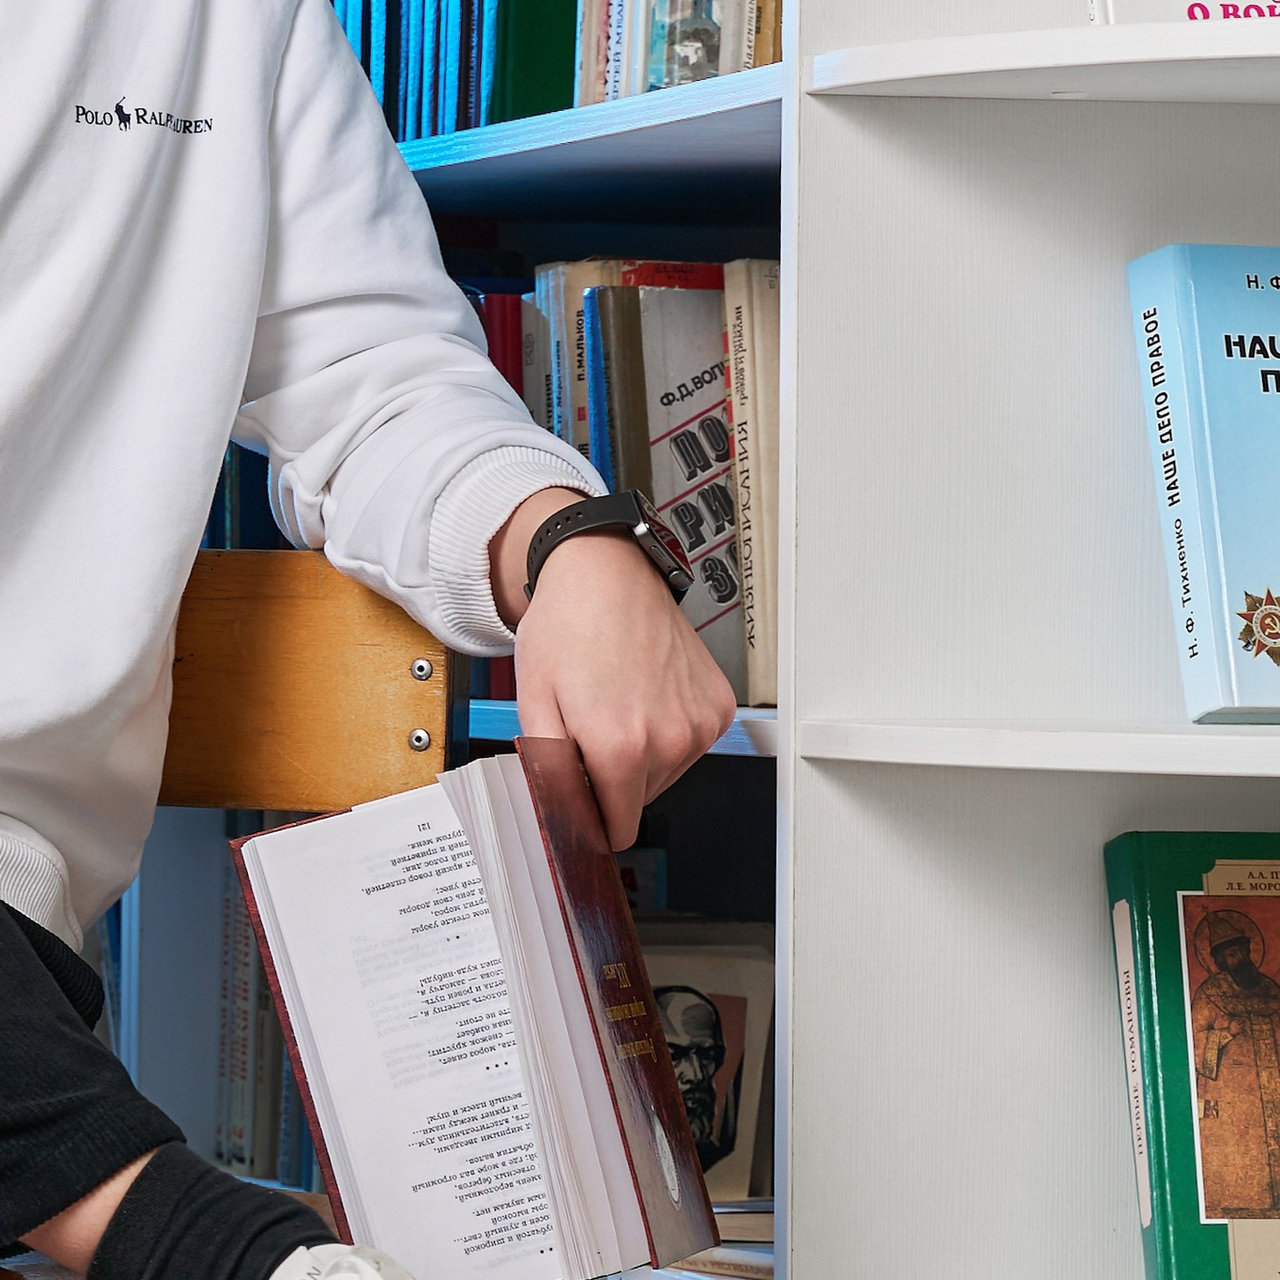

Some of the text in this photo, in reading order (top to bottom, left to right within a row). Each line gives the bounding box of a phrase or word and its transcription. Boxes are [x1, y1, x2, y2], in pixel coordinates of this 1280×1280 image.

[75, 105, 113, 126] POLO
[1246, 275, 1265, 290] Н.
[576, 309, 585, 381] П.МАЛЬКОВ
[670, 406, 731, 482] ПО
[1142, 306, 1200, 659] Н. Ф. Тихненко НАШЕ ДЕЛО ПРАВОЕ
[670, 471, 736, 553] РИ
[736, 421, 757, 649] ЖИЗНЕОПИСАНИЯ
[416, 821, 431, 832] 121
[406, 837, 434, 850] меня.
[389, 847, 438, 867] приветней
[421, 854, 449, 868] голос
[400, 862, 423, 874] дня:
[406, 869, 434, 882] говор
[433, 861, 464, 877] яркий
[360, 877, 408, 896] сплетней,
[434, 880, 460, 895] унес;
[454, 887, 476, 900] день
[1226, 882, 1247, 891] Л.Е.
[397, 899, 431, 916] дозоры
[431, 894, 454, 907] свои
[429, 903, 461, 917] мороз,
[409, 919, 440, 934] узоры
[439, 912, 471, 927] стекле
[418, 963, 479, 988] куда-нибудь!
[427, 977, 466, 994] замолчу
[446, 984, 474, 1000] ровен
[420, 994, 446, 1006] путь.
[431, 998, 471, 1015] застегну
[454, 1014, 485, 1028] стоит.
[455, 1023, 491, 1039] озябает
[426, 1031, 504, 1058] снежок хрустит;
[468, 1043, 497, 1058] мороз
[437, 1051, 468, 1065] сияет,
[1123, 969, 1144, 1156] ПЕРВЫЕ РОМАНОВЫ
[458, 1100, 488, 1114] плеск
[479, 1104, 511, 1120] грянет
[425, 1110, 451, 1125] шум!
[447, 1113, 479, 1129] между
[436, 1116, 510, 1140] властительница
[432, 1124, 524, 1154] мирными звездами,
[464, 1151, 495, 1165] валов.
[507, 1155, 524, 1165] где
[458, 1168, 476, 1179] вал
[475, 1161, 500, 1174] море
[410, 1173, 458, 1193] огромный
[453, 1175, 493, 1191] берегов,
[453, 1180, 515, 1203] вероломный,
[471, 1197, 525, 1217] звукам нет.
[489, 1207, 530, 1226] высокой
[482, 1221, 522, 1239] лунный
[462, 1236, 506, 1256] широкой
